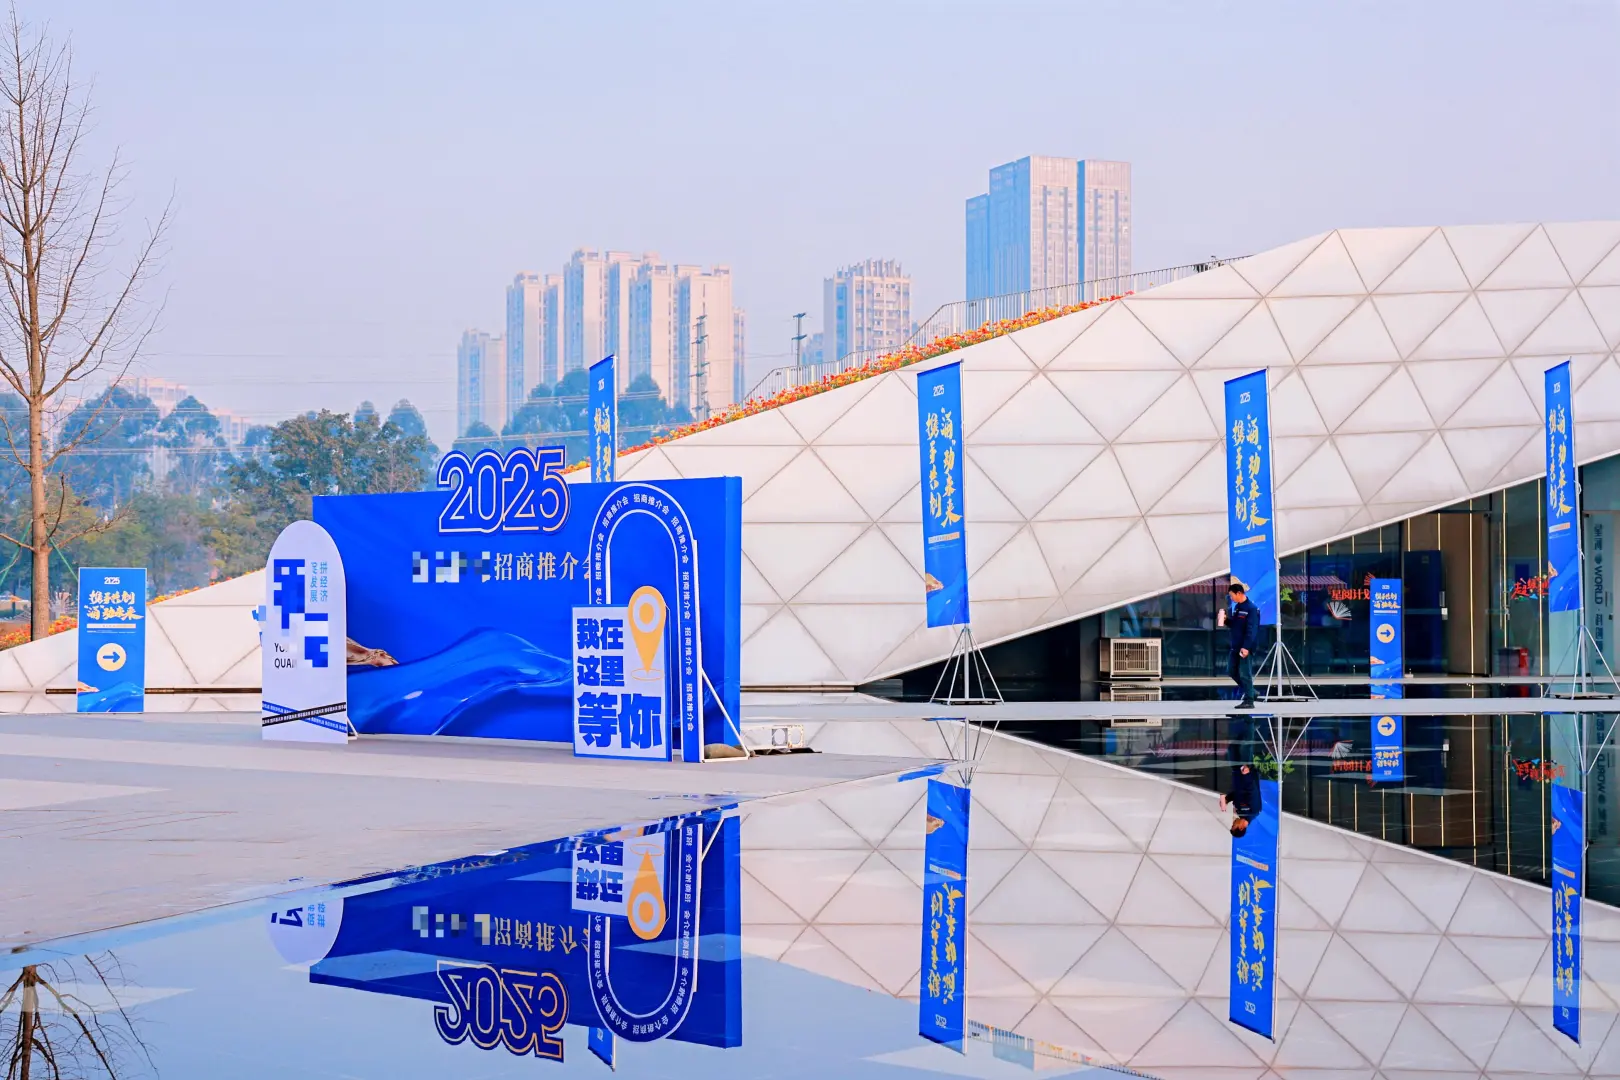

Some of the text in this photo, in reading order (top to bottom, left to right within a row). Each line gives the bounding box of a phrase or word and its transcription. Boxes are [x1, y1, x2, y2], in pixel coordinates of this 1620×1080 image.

[438, 447, 569, 535] 2025
[602, 496, 629, 529] 招商推介会
[633, 493, 670, 515] 招商推介会
[594, 532, 605, 580] 招商推介会
[671, 516, 689, 564] 招商推介会
[104, 576, 121, 585] 2025
[683, 571, 691, 620] 招商推介会
[1594, 565, 1603, 605] WORLD
[576, 618, 624, 650] 我在
[684, 627, 693, 676] 招商推介会
[577, 655, 625, 687] 这里
[577, 692, 662, 749] 等你
[686, 683, 694, 732] 招商推介会
